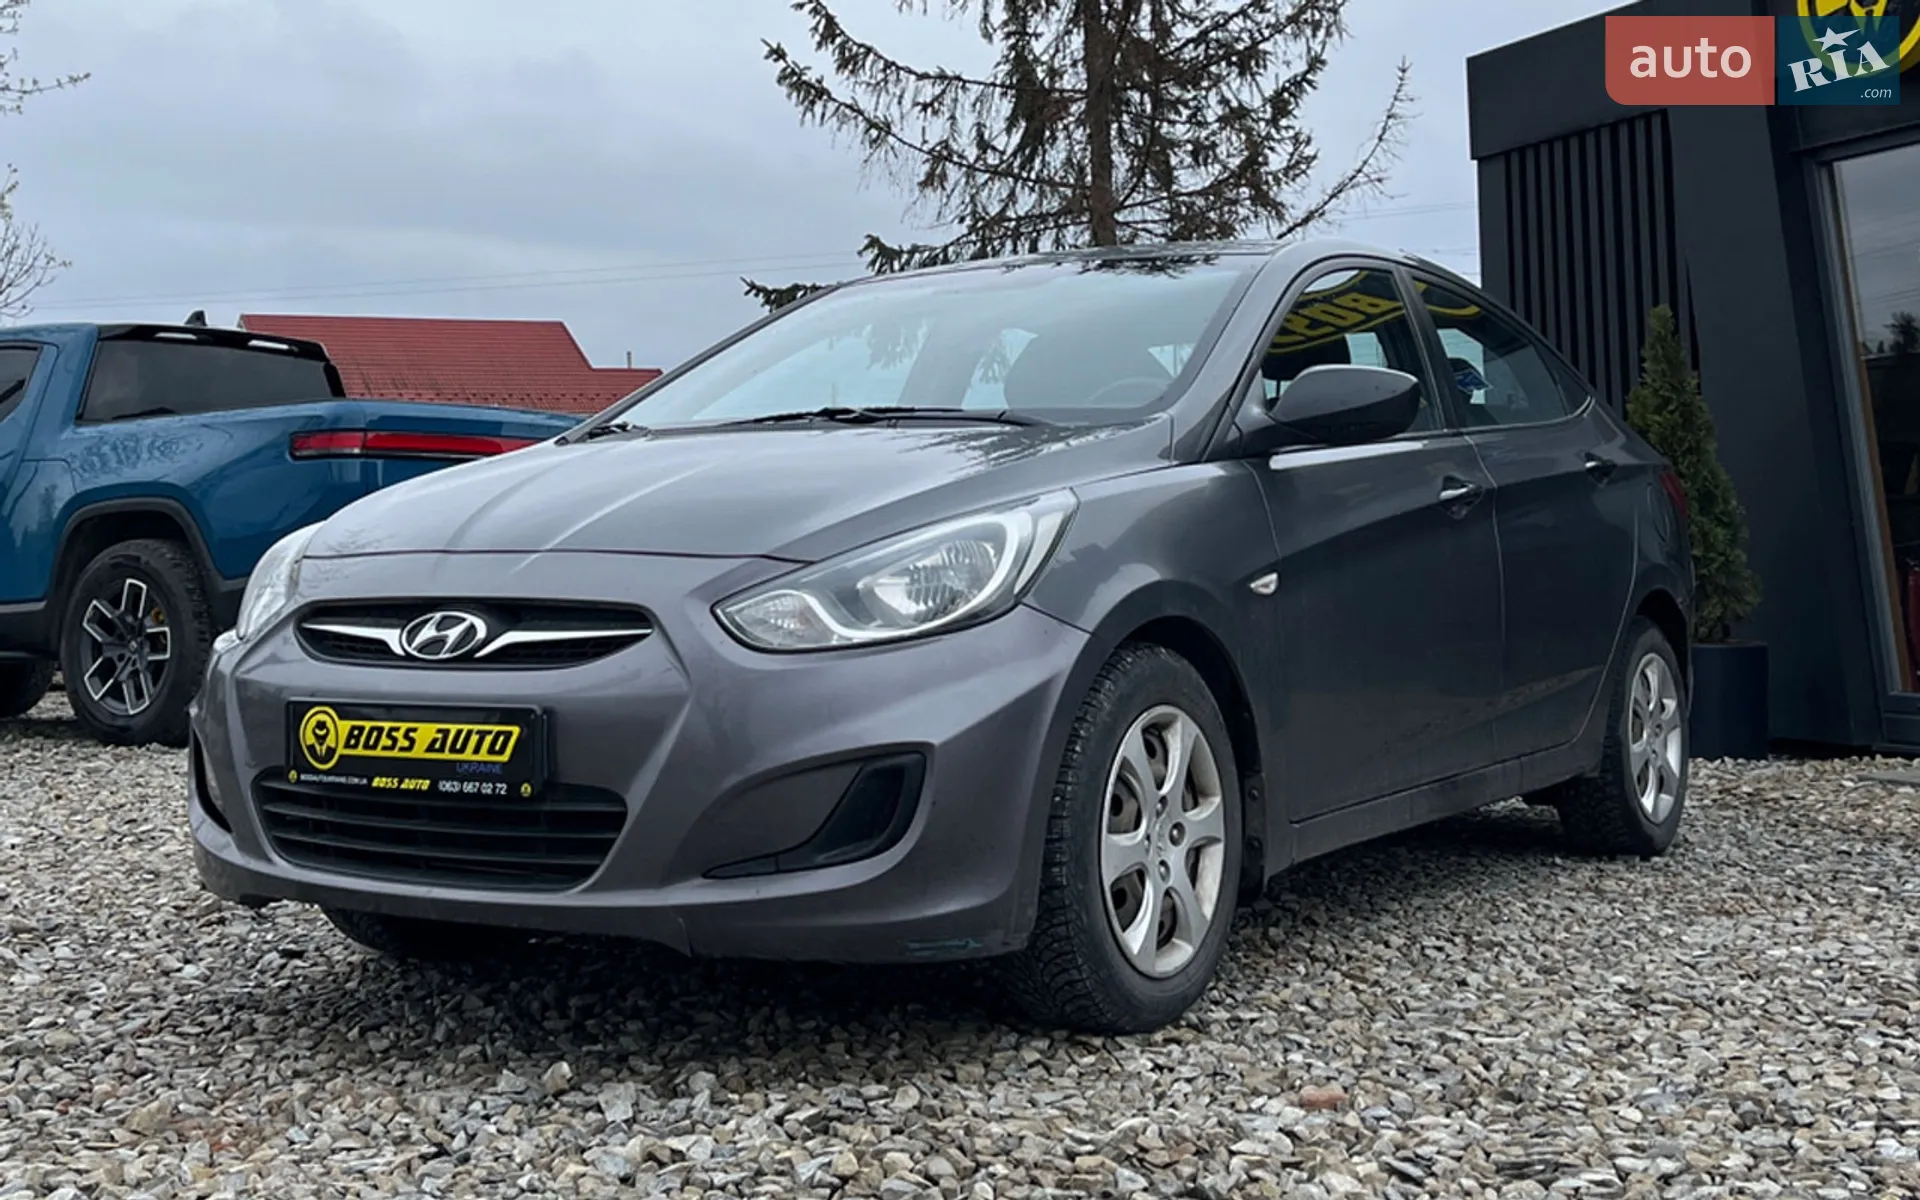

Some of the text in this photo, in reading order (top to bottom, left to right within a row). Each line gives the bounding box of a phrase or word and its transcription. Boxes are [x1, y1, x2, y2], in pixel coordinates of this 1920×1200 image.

[343, 724, 513, 756] BOSS AUTO
[371, 777, 399, 789] BOSS
[400, 779, 431, 791] AUTO
[494, 783, 508, 795] 72
